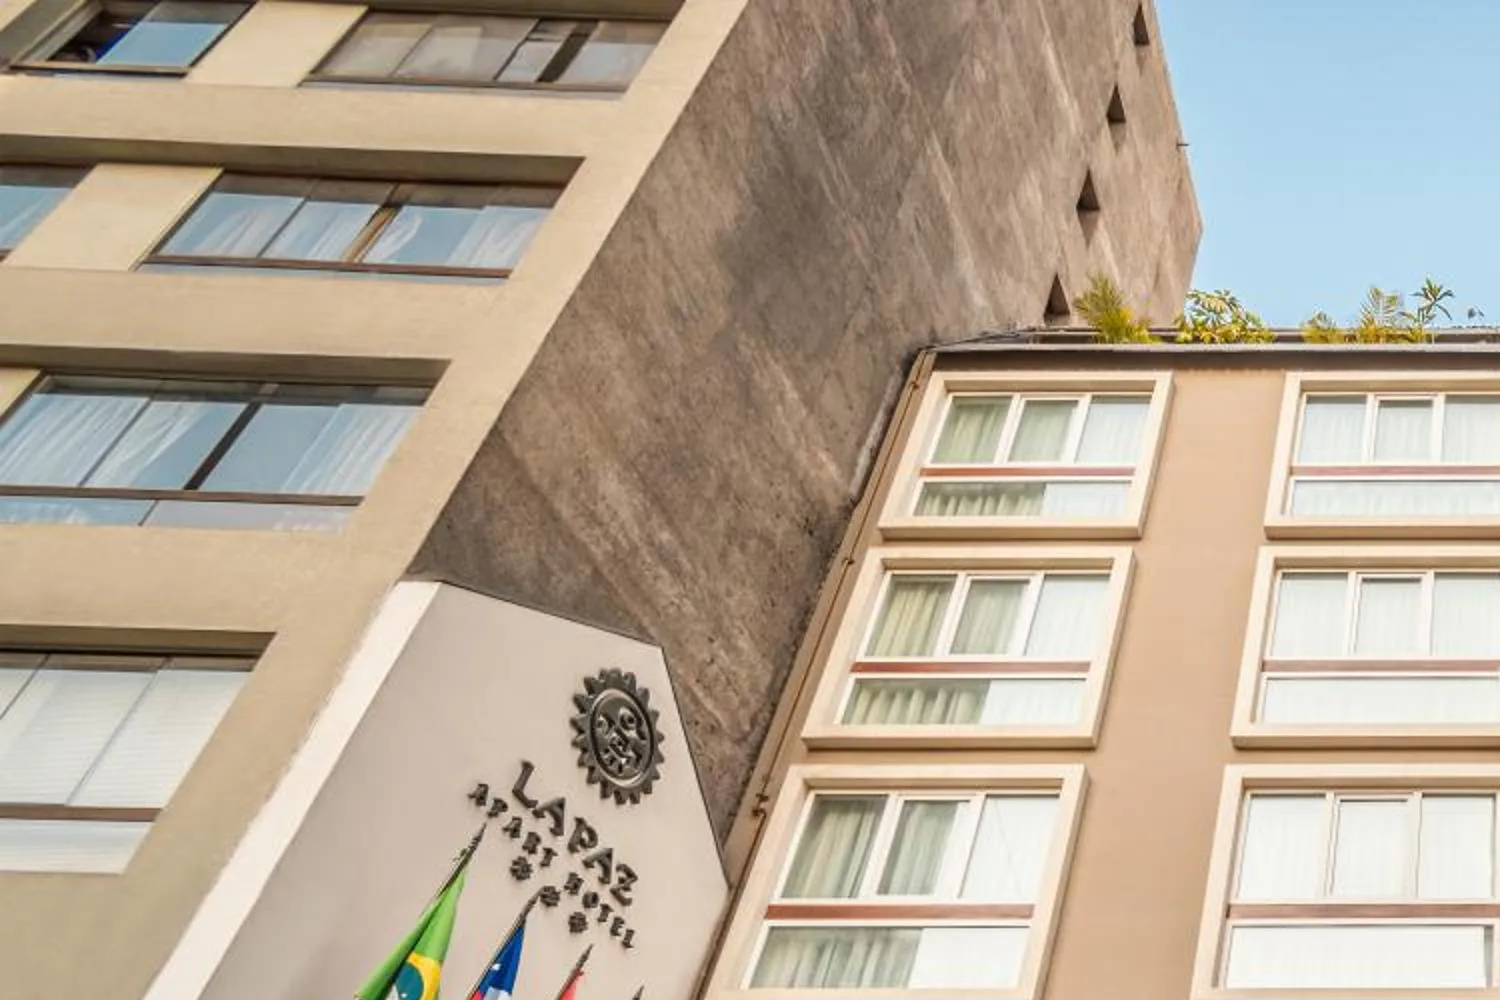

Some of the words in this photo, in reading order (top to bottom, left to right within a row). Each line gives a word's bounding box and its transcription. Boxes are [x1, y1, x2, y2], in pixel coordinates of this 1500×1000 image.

[467, 783, 558, 868] APART
[564, 872, 636, 949] HOTEL
[511, 760, 566, 836] LA
[567, 816, 639, 906] PAZ
